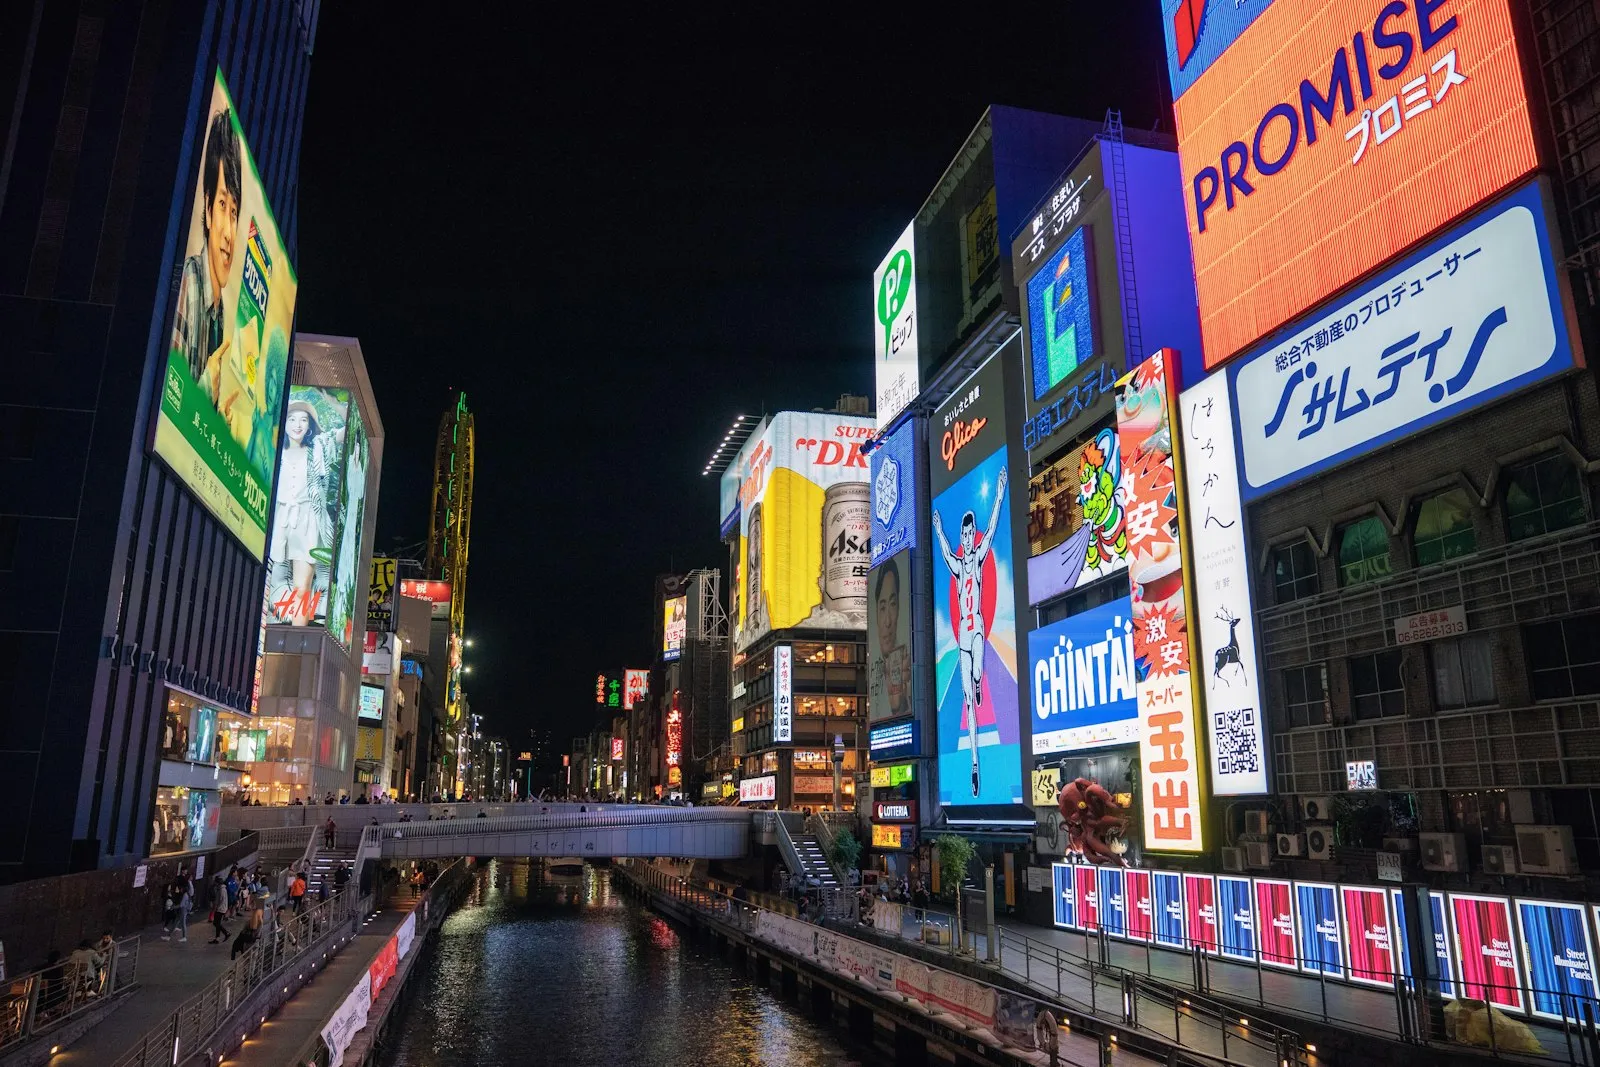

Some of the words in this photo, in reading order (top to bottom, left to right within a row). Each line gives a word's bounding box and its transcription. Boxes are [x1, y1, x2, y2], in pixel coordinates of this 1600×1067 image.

[1193, 0, 1458, 234] PROMISE
[1345, 48, 1468, 165] プロミス
[1275, 247, 1482, 373] 総合不動産のプロデューサー
[891, 311, 914, 355] ピップ
[1297, 326, 1453, 441] サムティ
[1023, 363, 1116, 451] 日商エステム
[835, 425, 877, 439] SUPE
[942, 417, 987, 471] Glico
[796, 437, 869, 468] “DR
[1029, 467, 1068, 502] かぜに
[1027, 491, 1077, 543] 改源
[852, 566, 869, 577] 生
[274, 589, 321, 620] H&M
[965, 574, 974, 632] グリコ
[1409, 611, 1449, 628] 広告募集
[1144, 612, 1184, 669] 激安
[1398, 621, 1464, 643] 06-6262-1313
[1035, 616, 1137, 720] CHINTAI
[1146, 684, 1183, 708] スーパー
[780, 695, 789, 738] かに道楽
[1148, 711, 1192, 840] 玉出
[1346, 761, 1375, 780] BAR
[884, 805, 909, 816] LOTTERIA
[1378, 855, 1399, 868] BAR
[1492, 938, 1509, 948] Street
[1566, 948, 1586, 960] Street
[1570, 968, 1593, 980] Panels.
